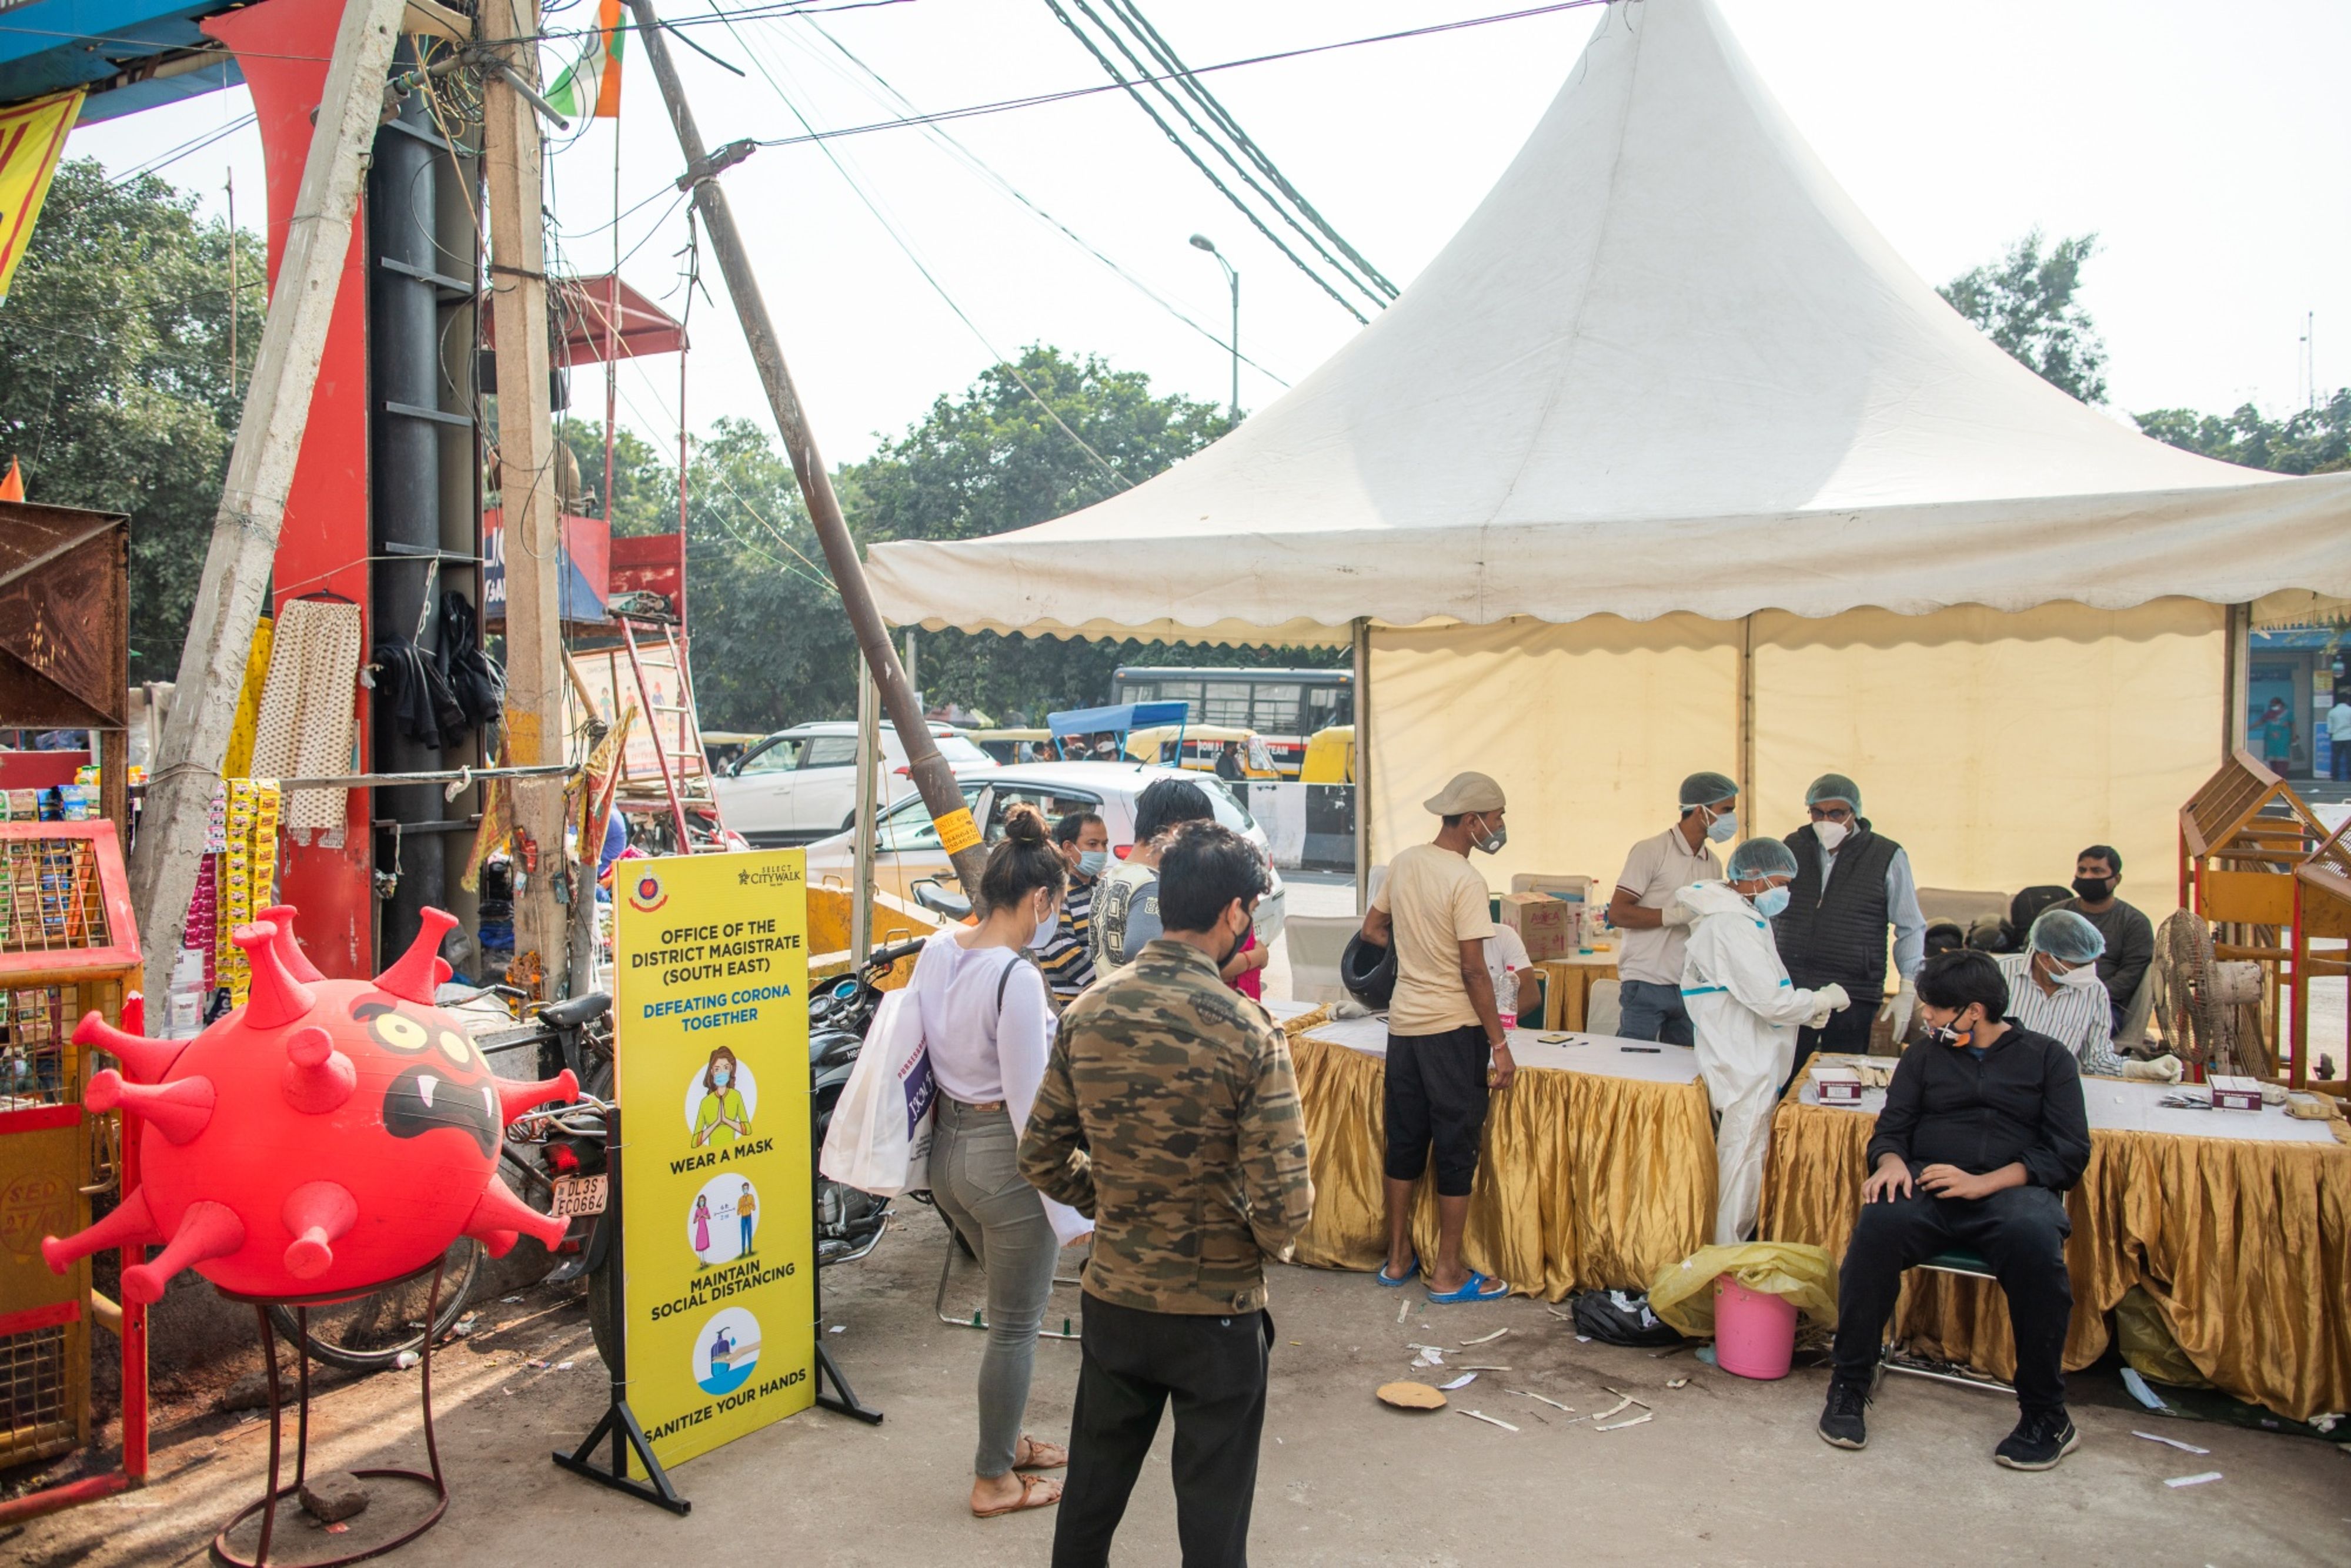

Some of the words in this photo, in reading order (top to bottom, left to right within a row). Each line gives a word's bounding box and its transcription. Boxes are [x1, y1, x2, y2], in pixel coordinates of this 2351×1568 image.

[1267, 745, 1289, 755] TEAM
[750, 871, 801, 884] CITYWALK
[762, 865, 792, 873] SELECT
[661, 925, 718, 944] OFFICE
[723, 922, 744, 938] OF
[748, 919, 776, 935] THE
[632, 946, 704, 968] DISTRICT
[709, 935, 800, 959] MAGISTRATE
[663, 964, 722, 987] (SOUTH
[727, 957, 770, 976] EAST)
[643, 994, 727, 1018] DEFEATING
[732, 984, 791, 1005] CORONA
[682, 1008, 758, 1032] TOGETHER
[670, 1152, 716, 1175] WEAR
[720, 1149, 730, 1163] A
[734, 1138, 773, 1159] MASK
[567, 1178, 598, 1197] DL3S
[691, 1259, 760, 1293] MAINTAIN
[651, 1292, 707, 1321] SOCIAL
[712, 1262, 795, 1301] DISTANCING
[644, 1406, 713, 1445] SANITIZE
[716, 1389, 756, 1414] YOUR
[760, 1368, 806, 1398] HANDS
